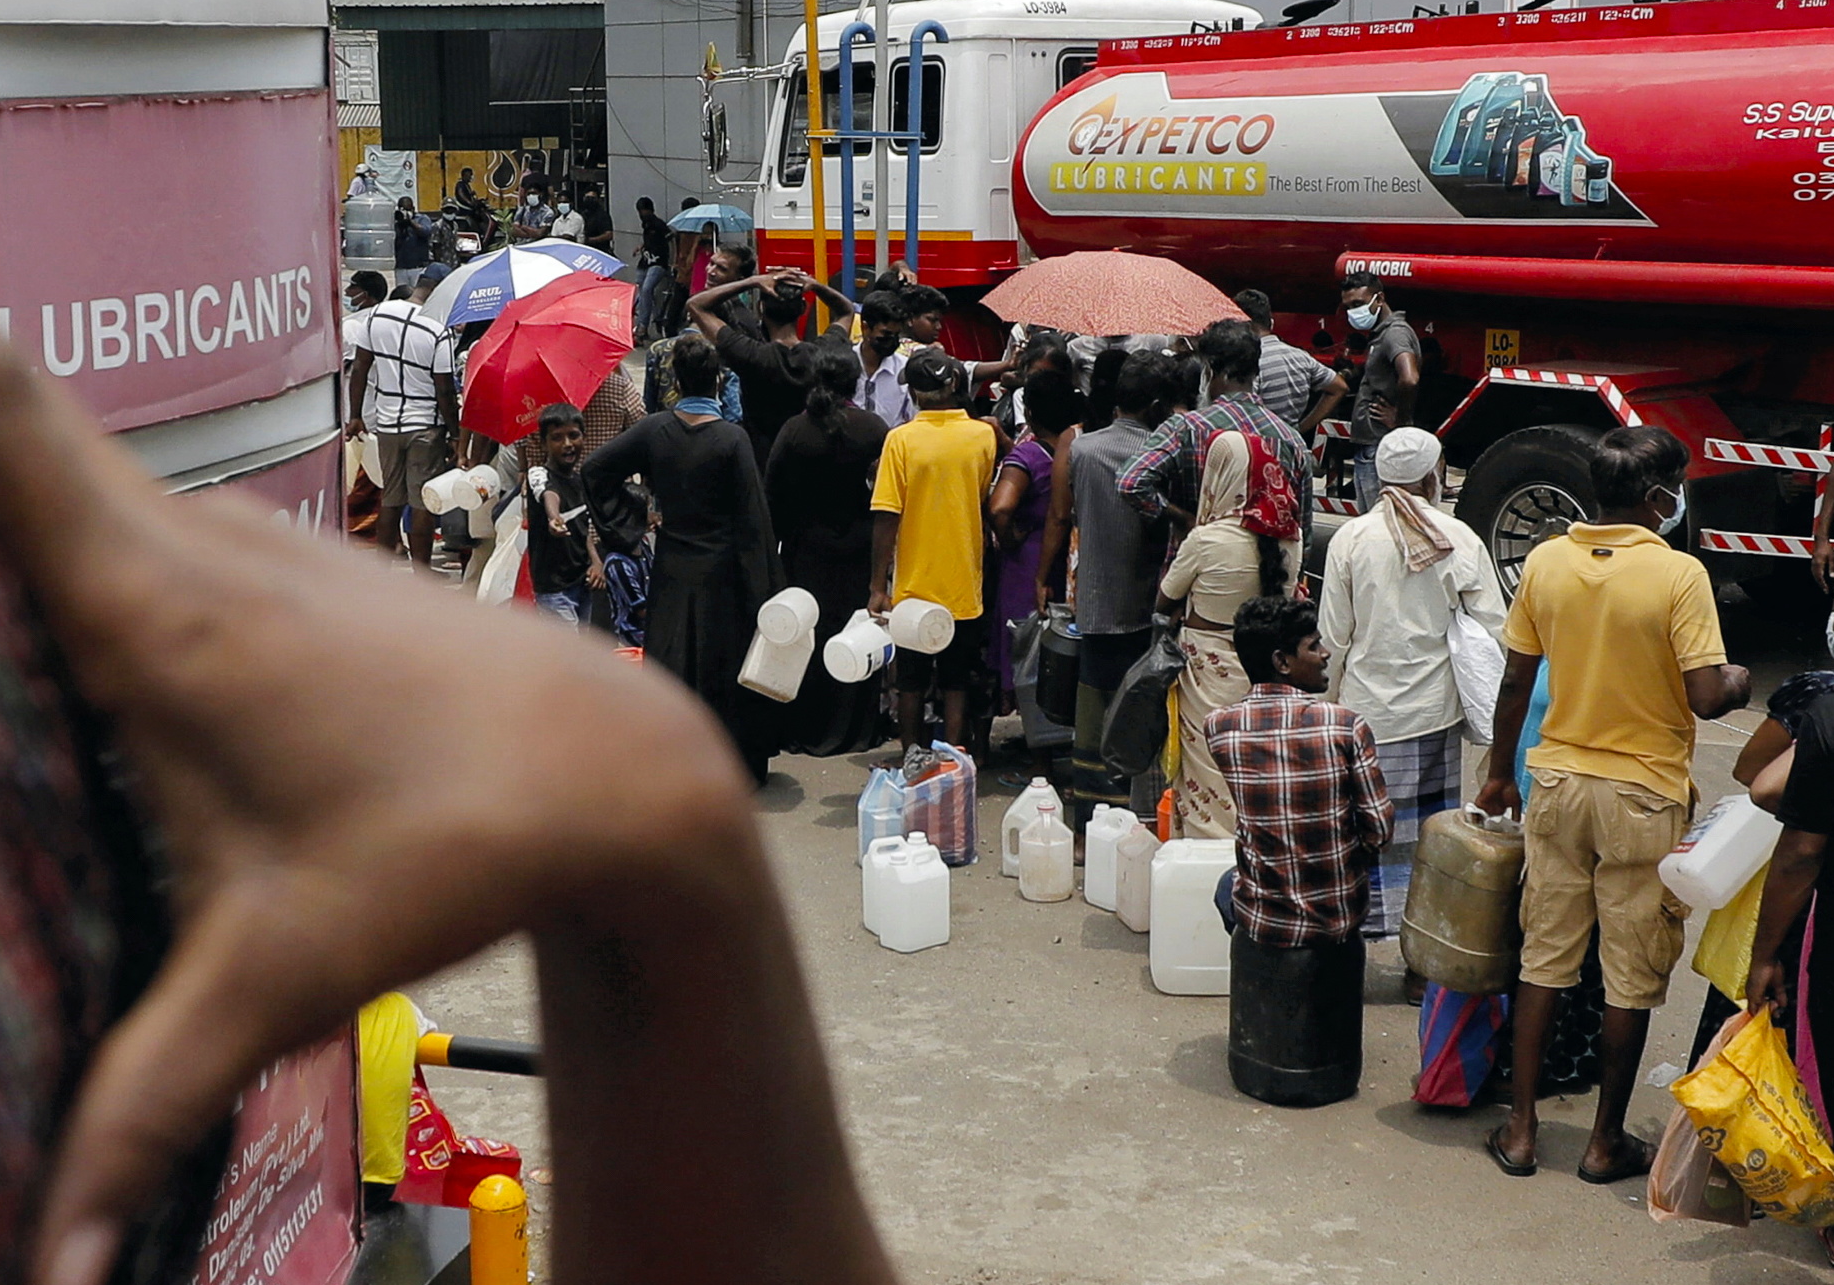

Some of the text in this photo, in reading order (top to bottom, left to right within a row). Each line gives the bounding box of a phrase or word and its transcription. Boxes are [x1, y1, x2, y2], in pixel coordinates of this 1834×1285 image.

[1024, 0, 1067, 15] LO-3984
[1776, 0, 1785, 10] 4
[1497, 17, 1506, 27] 3
[1286, 31, 1293, 41] 2
[1743, 102, 1785, 124] S.S
[1055, 165, 1259, 192] LUBRICANTS
[1268, 175, 1422, 193] The Best From The Best
[1345, 260, 1413, 276] NO MOBIL
[469, 286, 503, 300] ARUL
[1424, 322, 1434, 334] 4
[1492, 333, 1514, 352] LO-
[242, 1121, 278, 1171] Name
[199, 1178, 264, 1252] troleum
[262, 1181, 324, 1279] 0115113131
